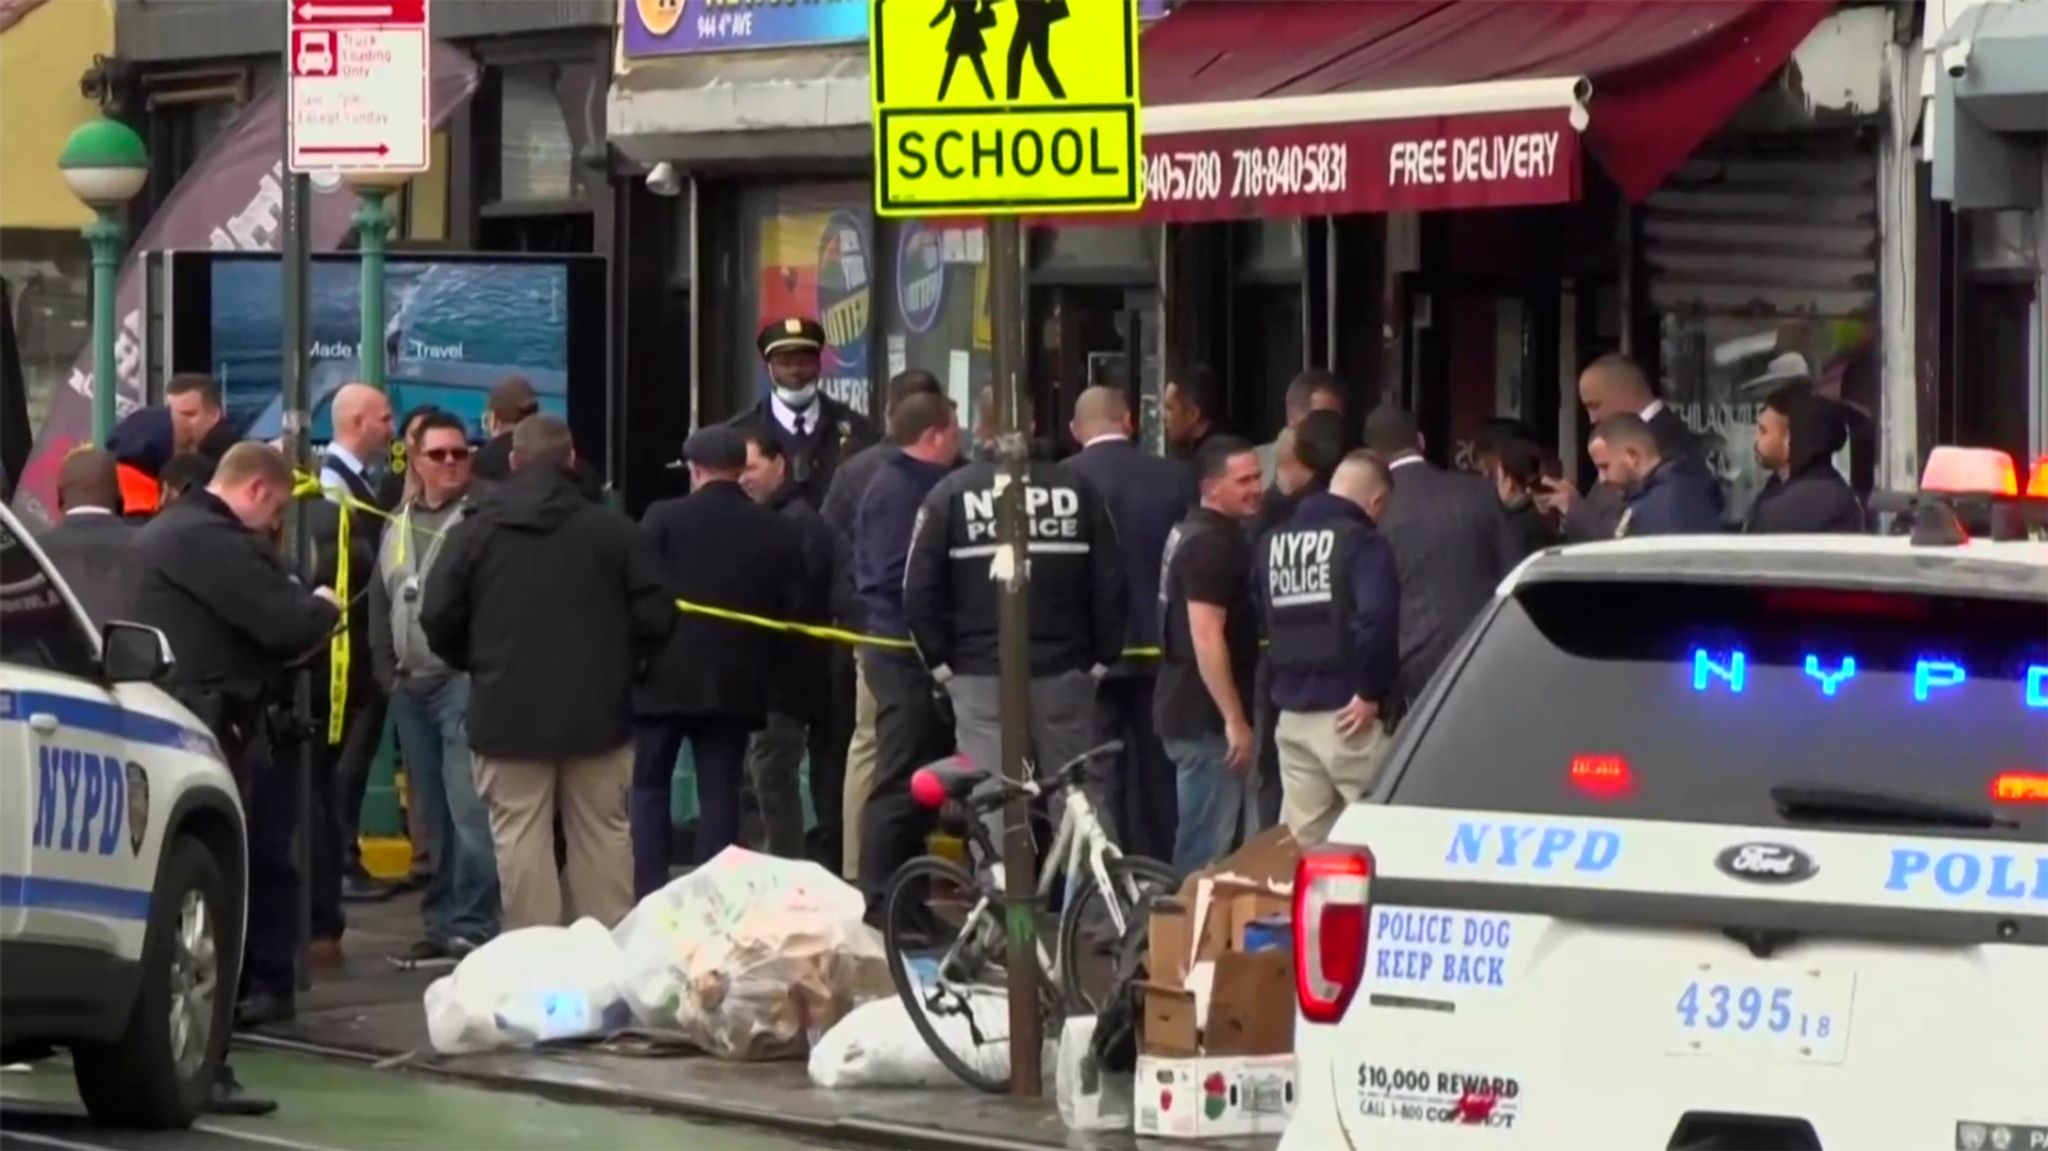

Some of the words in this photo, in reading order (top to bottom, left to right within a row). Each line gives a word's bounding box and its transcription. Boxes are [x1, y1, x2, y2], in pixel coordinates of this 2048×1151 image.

[732, 12, 752, 35] AVE
[343, 67, 369, 77] Only
[346, 111, 388, 124] unday
[898, 127, 1119, 179] SCHOOL
[1389, 139, 1447, 186] FREE
[1452, 131, 1559, 183] DELIVERY
[414, 342, 463, 359] Travel
[963, 486, 1079, 522] NPD
[967, 517, 1079, 541] PICE
[1269, 528, 1335, 568] NYPD
[1269, 563, 1332, 597] POLICE
[32, 744, 125, 856] NYPD
[1446, 823, 1621, 872] NYPD
[1733, 845, 1795, 875] Ford
[1377, 911, 1453, 945] POLICE
[1463, 917, 1511, 949] DOG
[1376, 949, 1433, 981] KEEP
[1442, 953, 1505, 986] BACK
[1676, 981, 1792, 1032] 4395
[1799, 1014, 1831, 1039] 18
[1358, 1062, 1430, 1094] $10,000
[1437, 1072, 1519, 1099] REWARD
[1360, 1099, 1386, 1118] CALL
